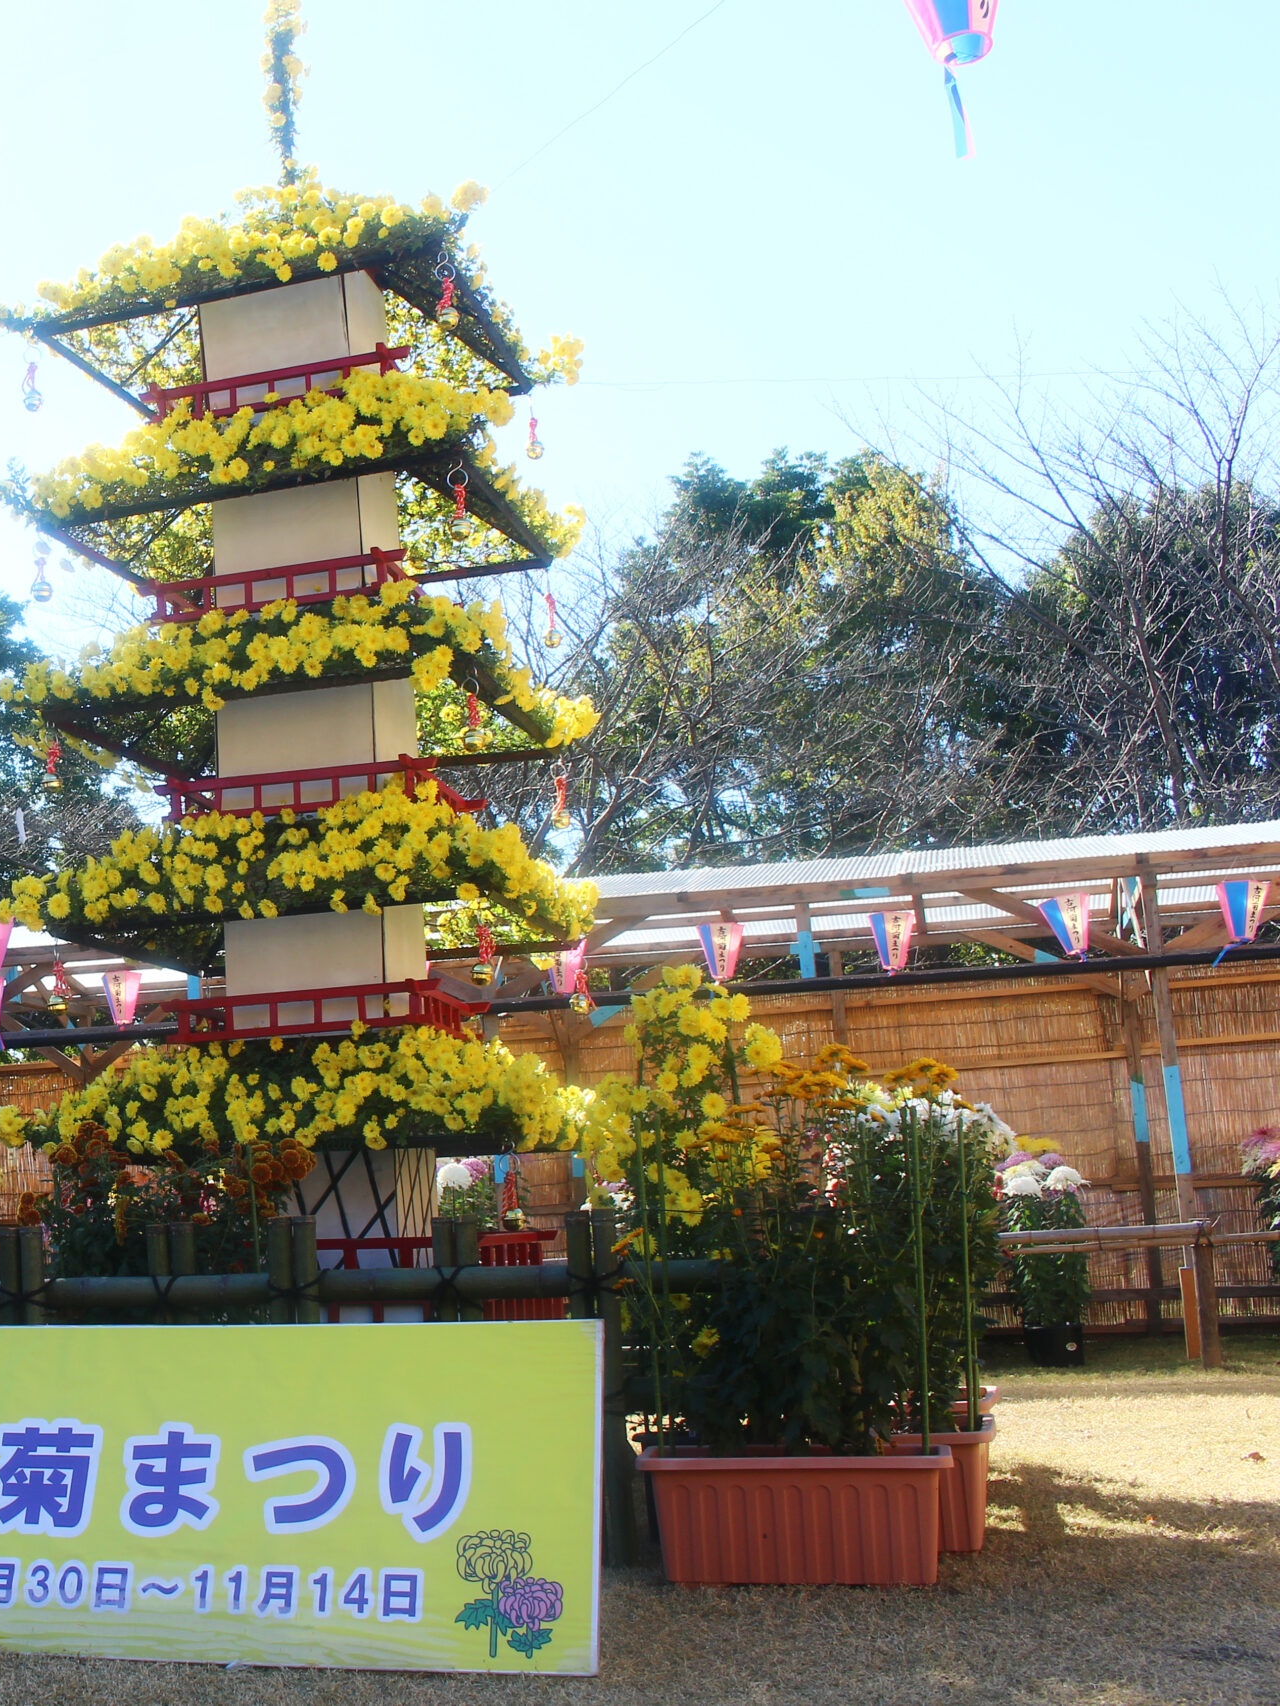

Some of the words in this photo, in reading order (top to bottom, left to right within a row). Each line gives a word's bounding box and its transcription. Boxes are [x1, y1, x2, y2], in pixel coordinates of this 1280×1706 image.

[1066, 897, 1081, 944] 古河菊まつり
[1249, 885, 1262, 932] 古河菊まつり
[891, 915, 902, 960] 古河菊まつり
